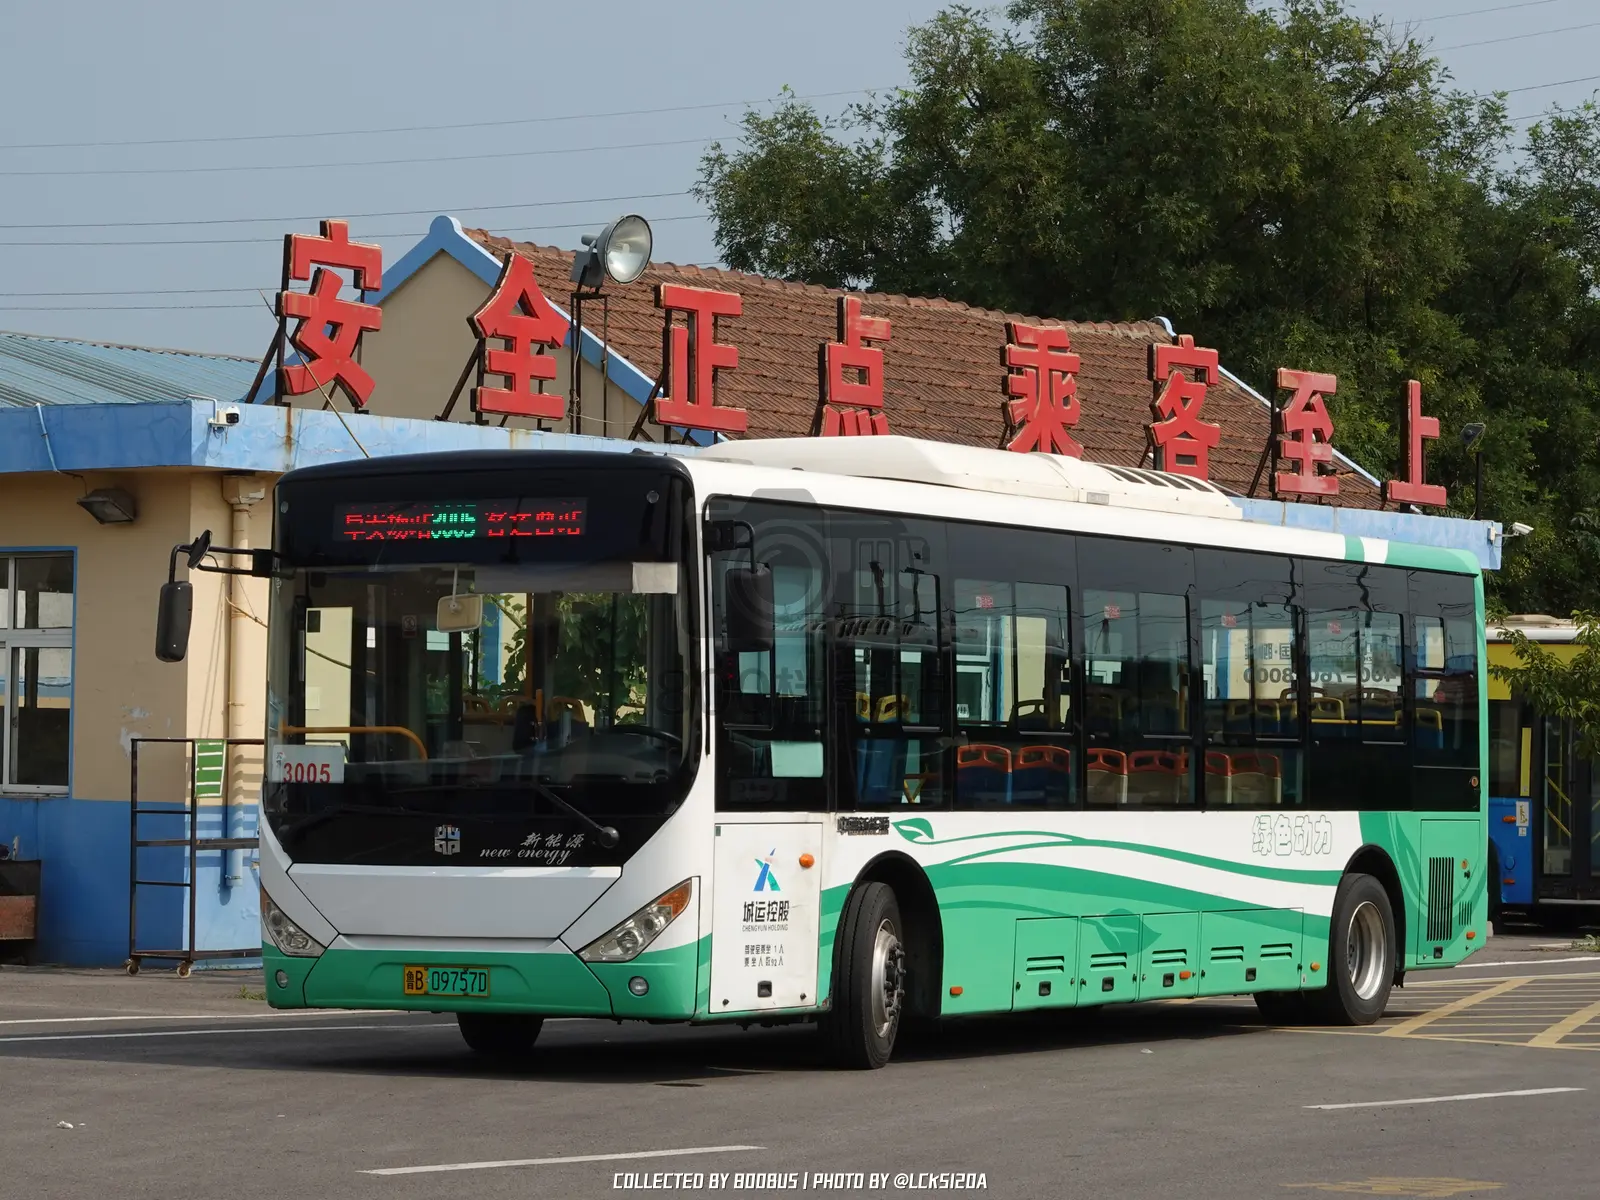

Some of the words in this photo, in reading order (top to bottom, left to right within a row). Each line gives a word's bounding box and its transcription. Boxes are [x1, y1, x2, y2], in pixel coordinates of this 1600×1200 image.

[283, 762, 331, 784] 3005
[520, 832, 585, 849] 新能源
[1252, 813, 1333, 856] 绿色动力
[479, 847, 513, 858] new
[517, 847, 574, 865] energy
[743, 900, 790, 923] 城运控股
[742, 923, 768, 932] CHENGYUN
[768, 923, 789, 932] HOLDING
